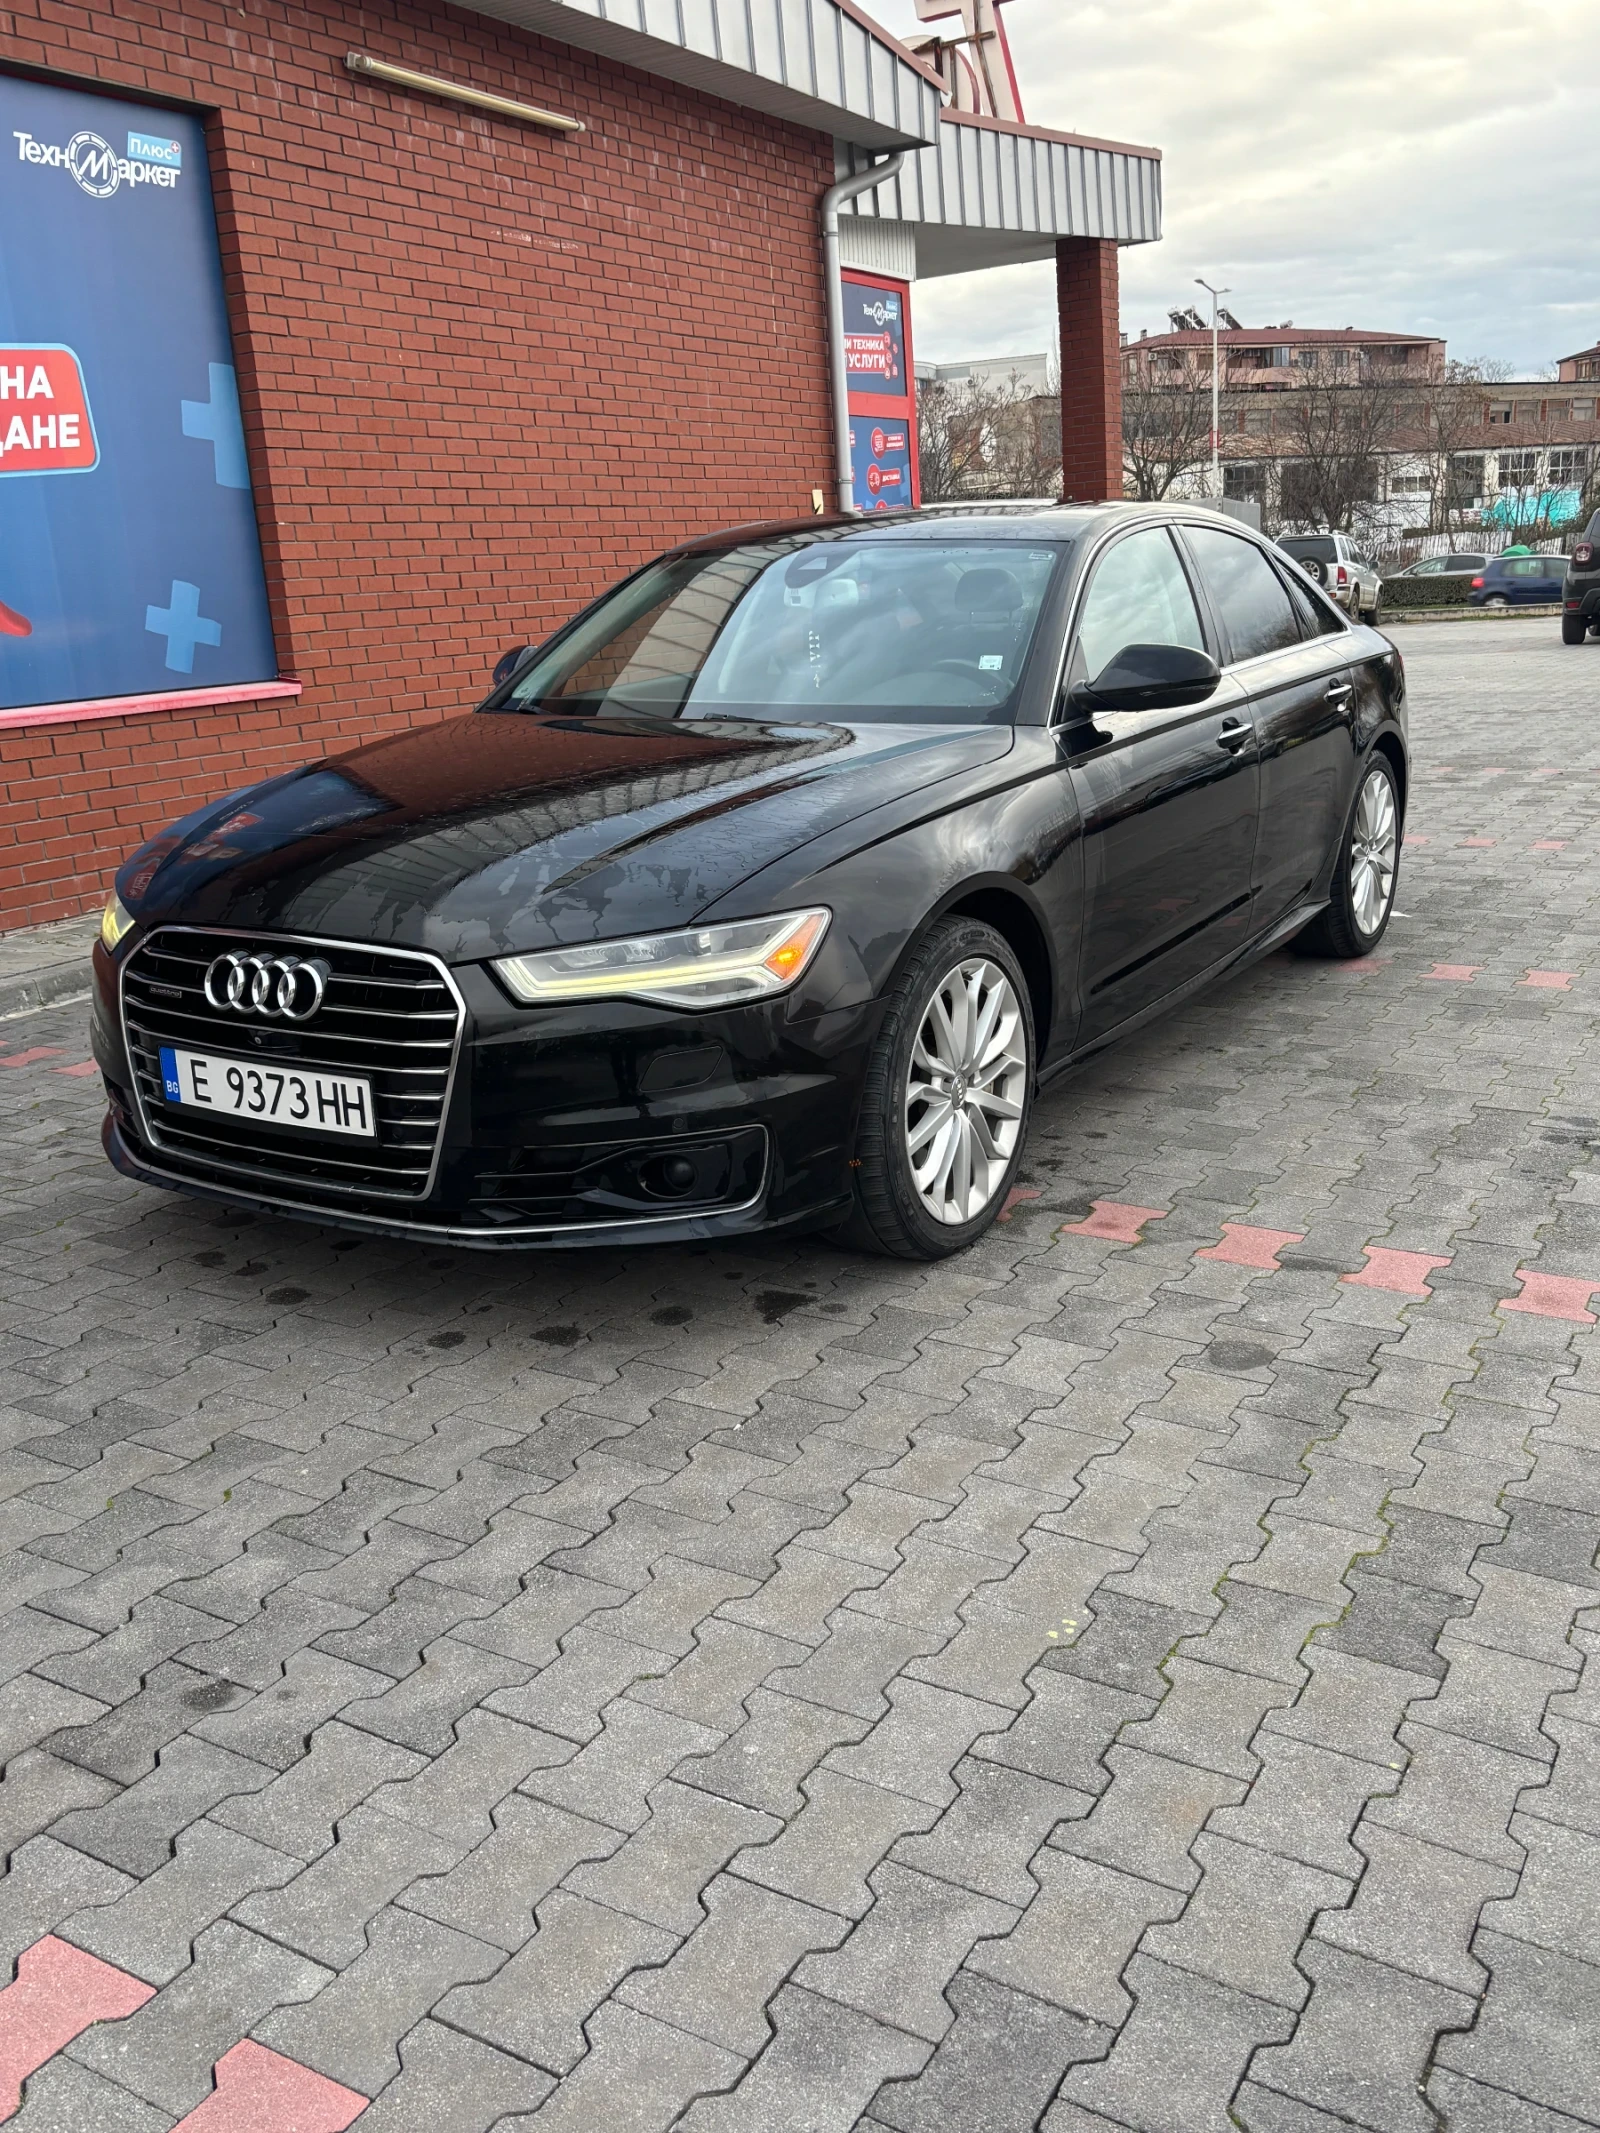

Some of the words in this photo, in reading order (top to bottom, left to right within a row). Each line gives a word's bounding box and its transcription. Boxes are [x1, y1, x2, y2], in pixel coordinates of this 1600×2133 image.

[130, 137, 173, 160] Плюс
[853, 339, 884, 350] ТЕХНИКА
[848, 354, 885, 368] УСЛУГИ
[0, 365, 55, 399] НА
[0, 413, 80, 457] АНЕ
[166, 1079, 179, 1093] BG
[190, 1059, 212, 1103] E
